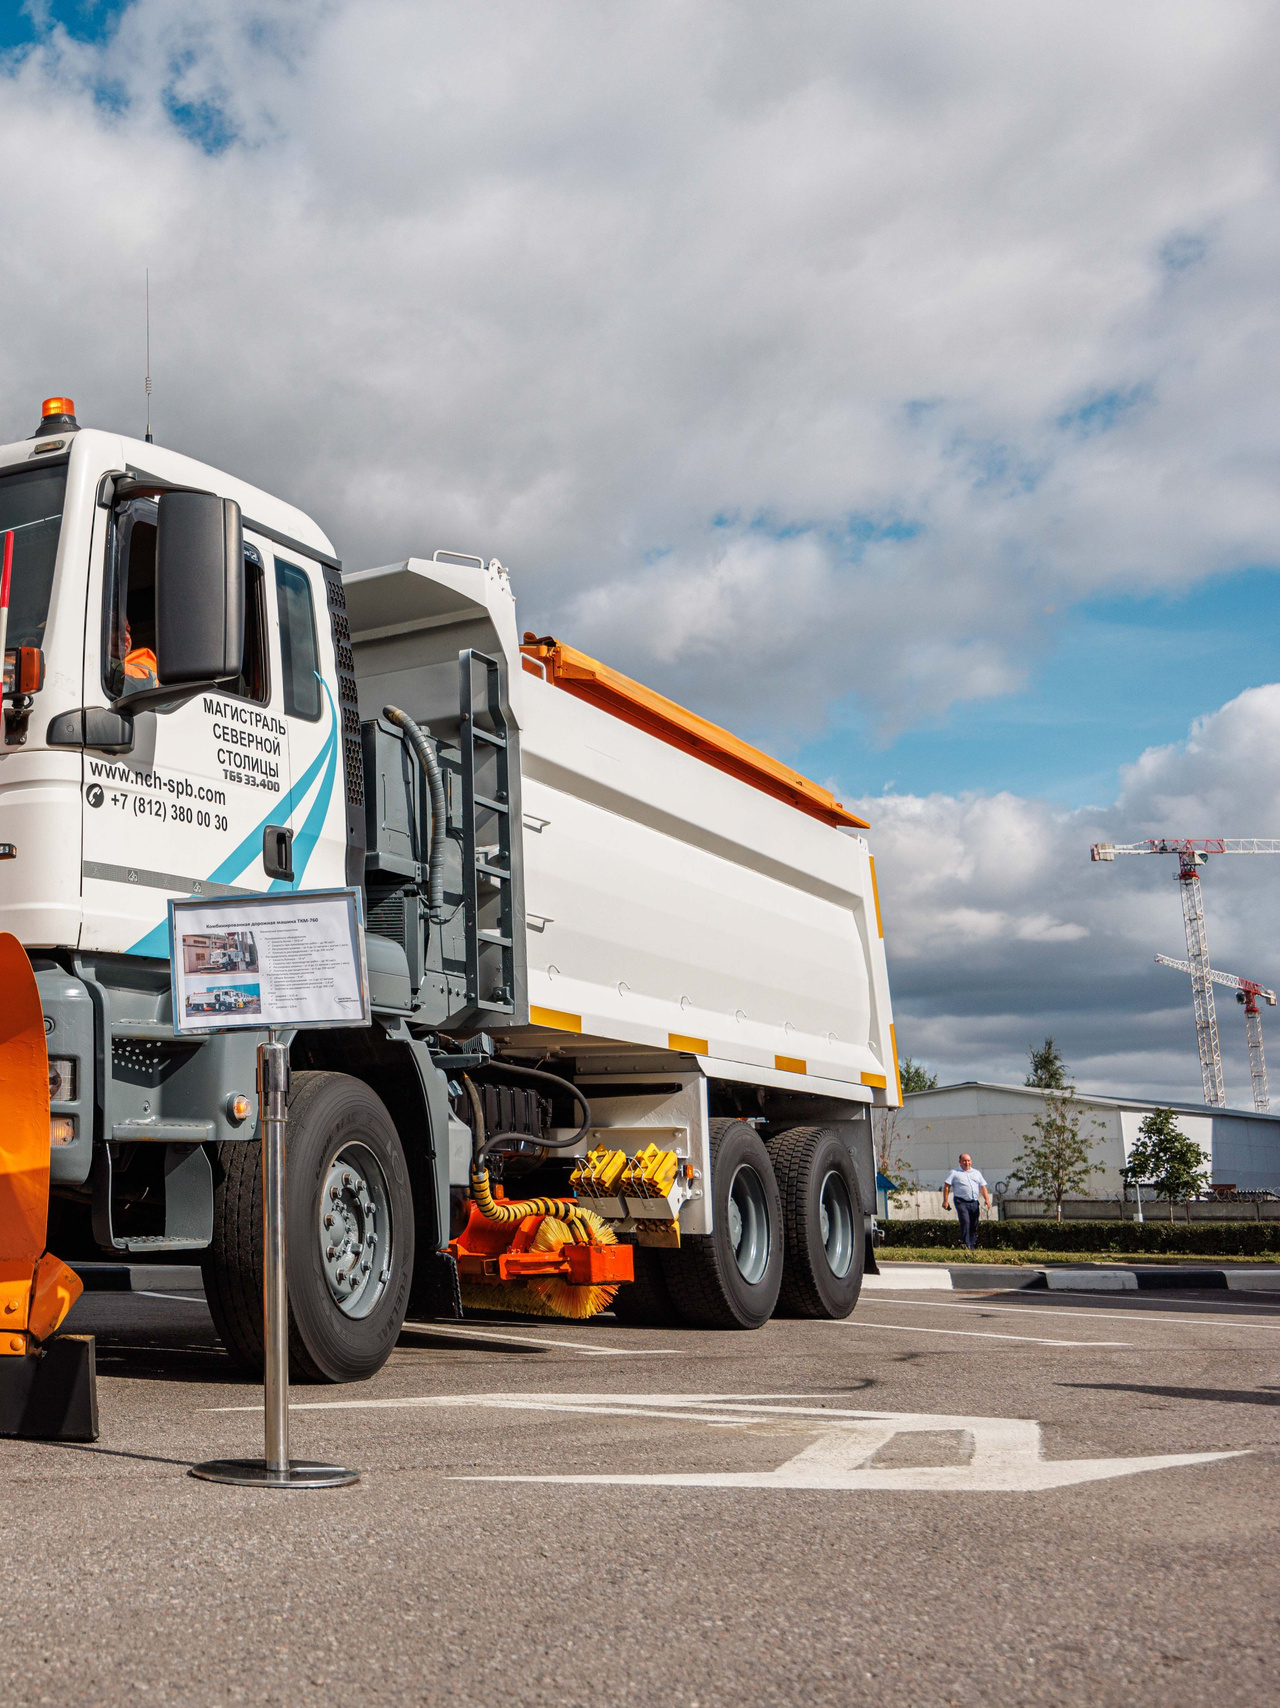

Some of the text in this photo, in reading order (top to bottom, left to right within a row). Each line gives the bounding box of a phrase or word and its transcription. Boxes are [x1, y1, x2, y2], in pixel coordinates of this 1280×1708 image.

[203, 697, 286, 736] МАГИСТРАЛЬ
[213, 723, 281, 756] СЕВЕРНОЙ
[217, 748, 279, 778] СТОЛИЦЫ
[89, 761, 226, 806] www.nch-spb.com
[111, 793, 228, 832] +7 (812) 380 00 30
